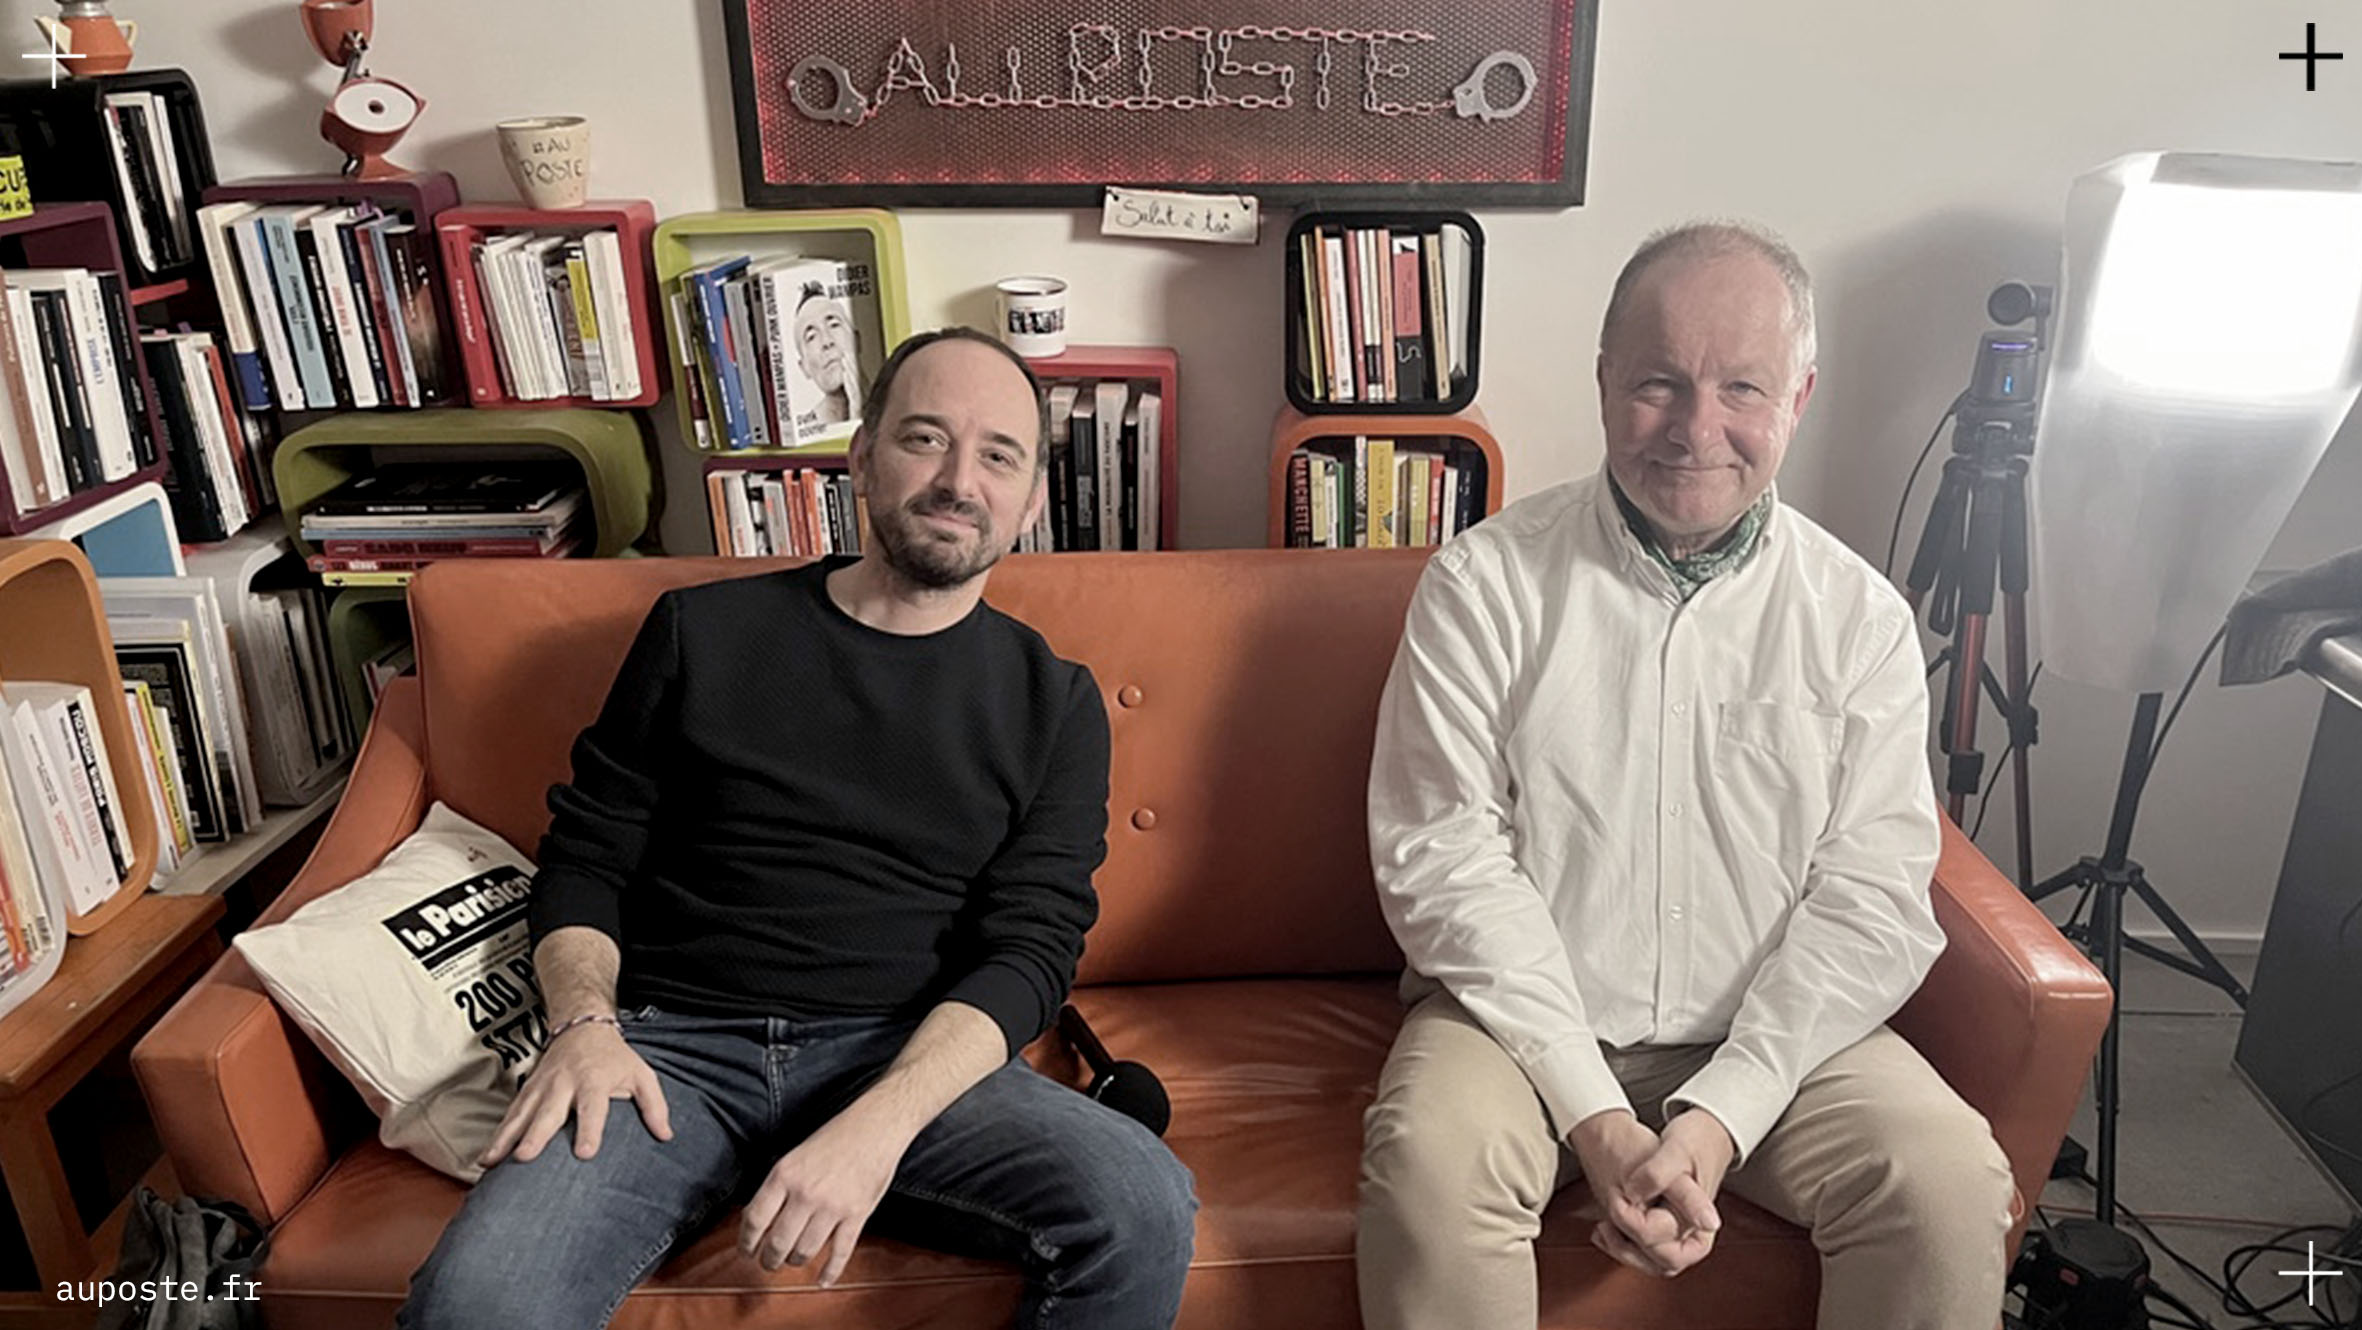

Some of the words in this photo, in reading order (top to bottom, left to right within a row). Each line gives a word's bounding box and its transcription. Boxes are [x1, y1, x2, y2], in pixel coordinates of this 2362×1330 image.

[520, 159, 584, 187] POSTE
[1115, 200, 1178, 228] Salut
[1203, 208, 1231, 232] toi
[767, 316, 781, 342] PUNK
[1293, 457, 1310, 533] MANCHETTE
[418, 876, 533, 938] Parisien
[455, 972, 523, 1032] 200
